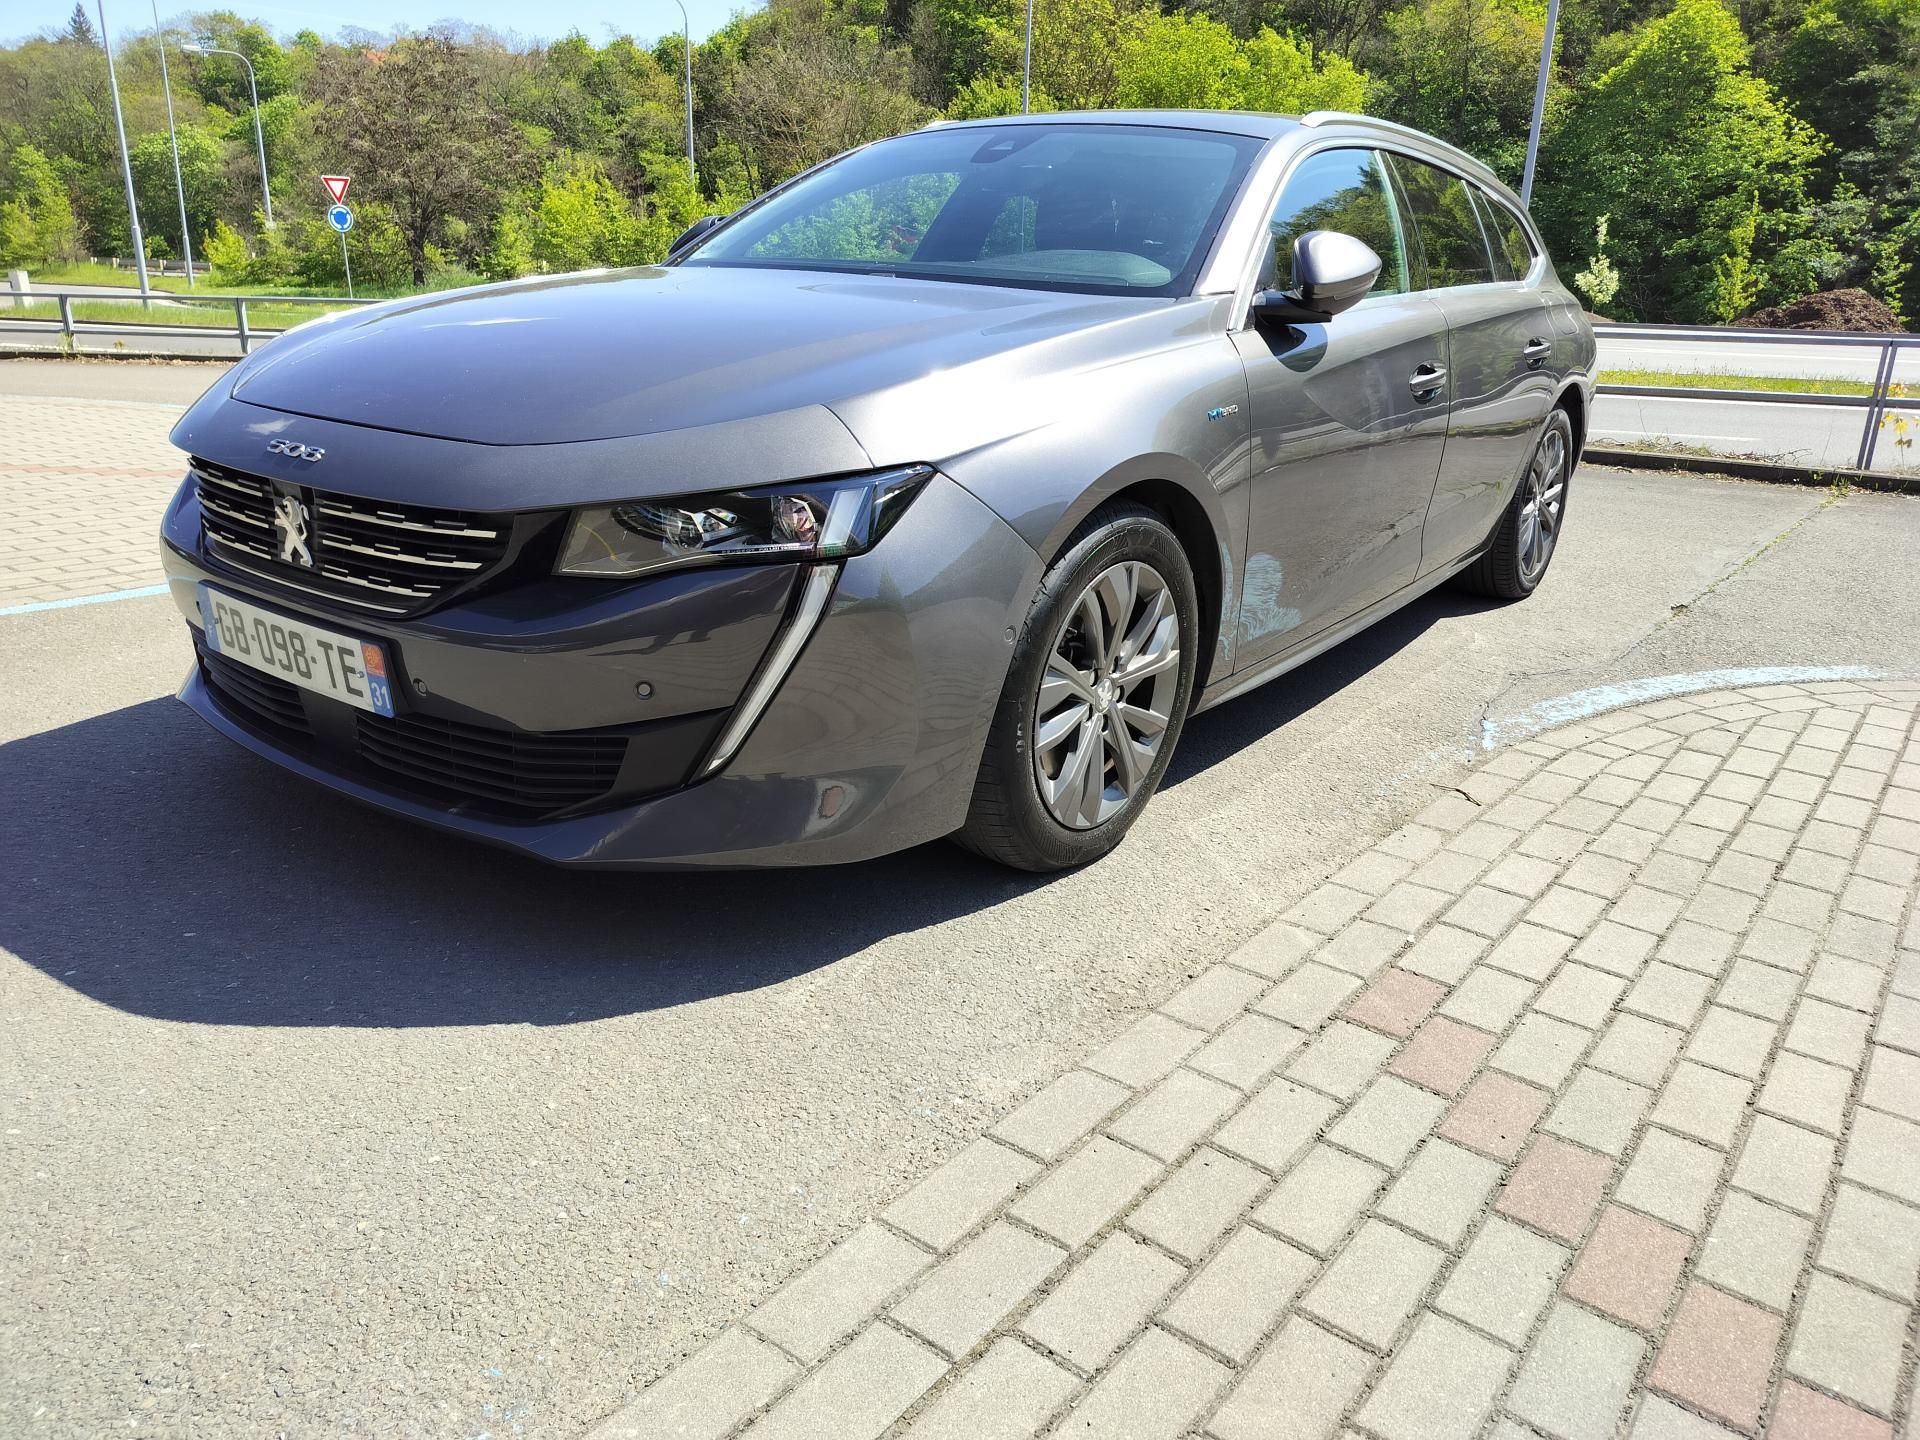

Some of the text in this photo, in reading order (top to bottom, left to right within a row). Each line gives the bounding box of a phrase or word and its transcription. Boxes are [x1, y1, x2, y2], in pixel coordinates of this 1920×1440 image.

[266, 438, 326, 462] 508
[215, 601, 364, 698] GB-098-TE
[371, 682, 392, 709] 31
